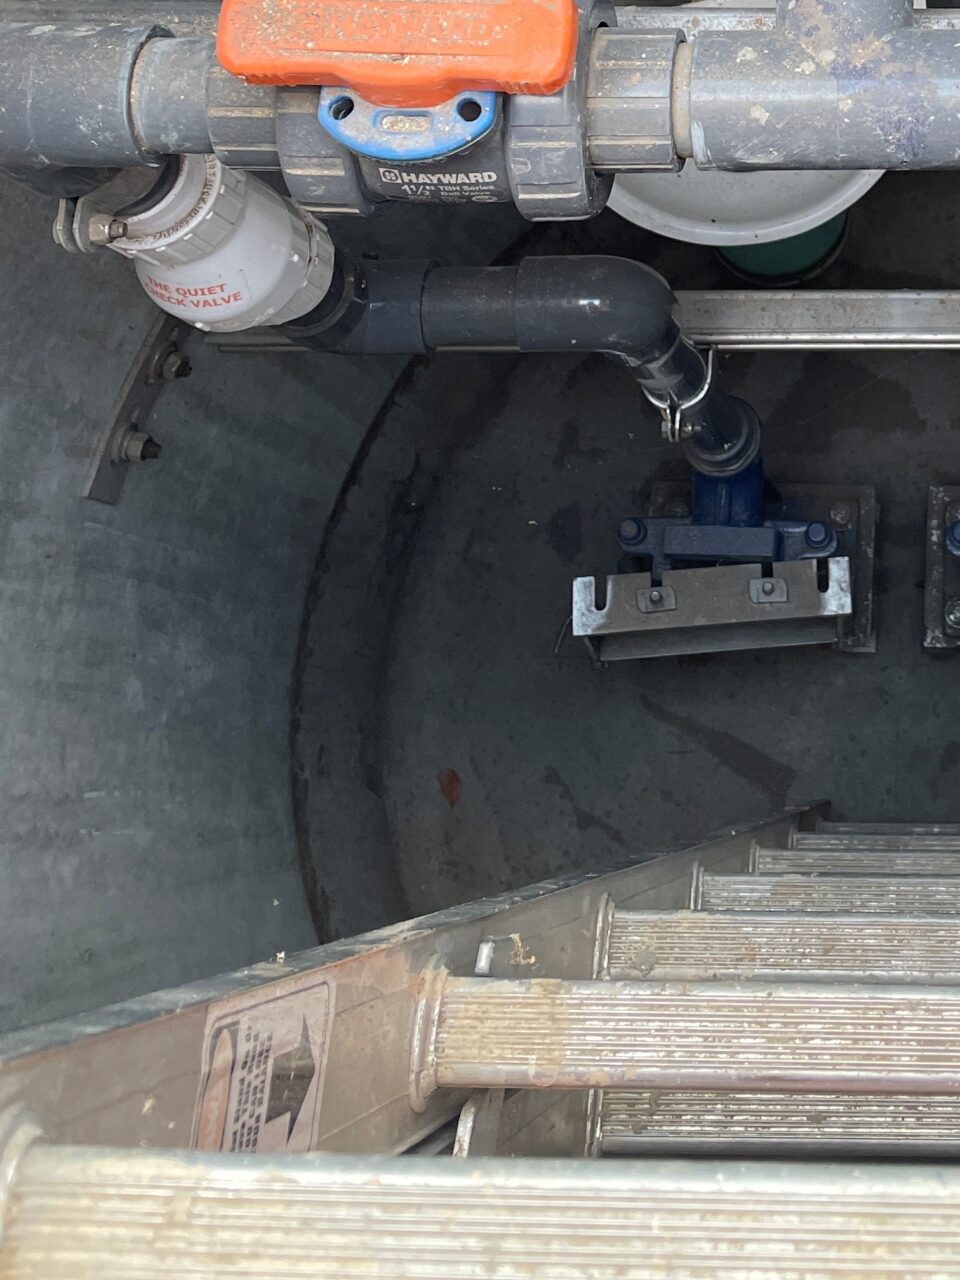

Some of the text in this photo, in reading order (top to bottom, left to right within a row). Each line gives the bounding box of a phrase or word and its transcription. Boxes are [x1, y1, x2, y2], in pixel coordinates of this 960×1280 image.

[402, 172, 497, 184] HAYWARD
[145, 282, 243, 308] CHECK VALVE
[147, 276, 226, 298] THE QUIET
